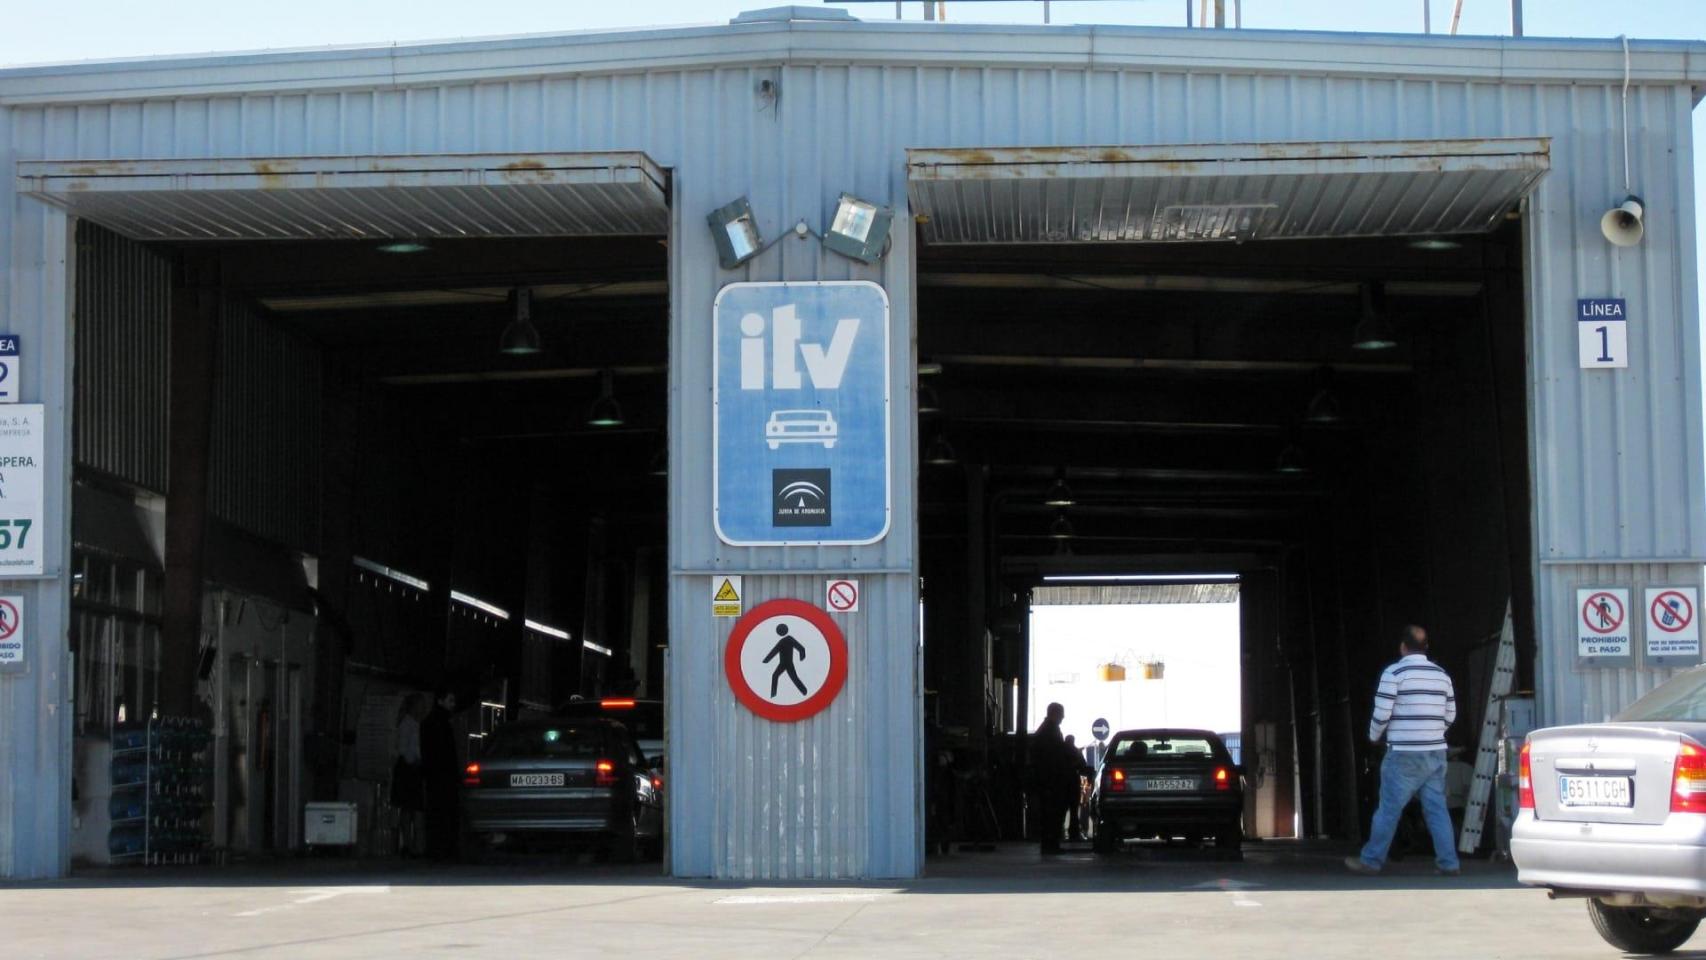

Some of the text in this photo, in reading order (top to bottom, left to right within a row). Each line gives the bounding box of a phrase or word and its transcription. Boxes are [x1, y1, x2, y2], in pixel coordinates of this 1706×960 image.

[1583, 301, 1622, 316] LÍNEA
[740, 303, 861, 390] itv
[1595, 325, 1614, 362] 1
[1569, 780, 1627, 799] 6511 CGH
